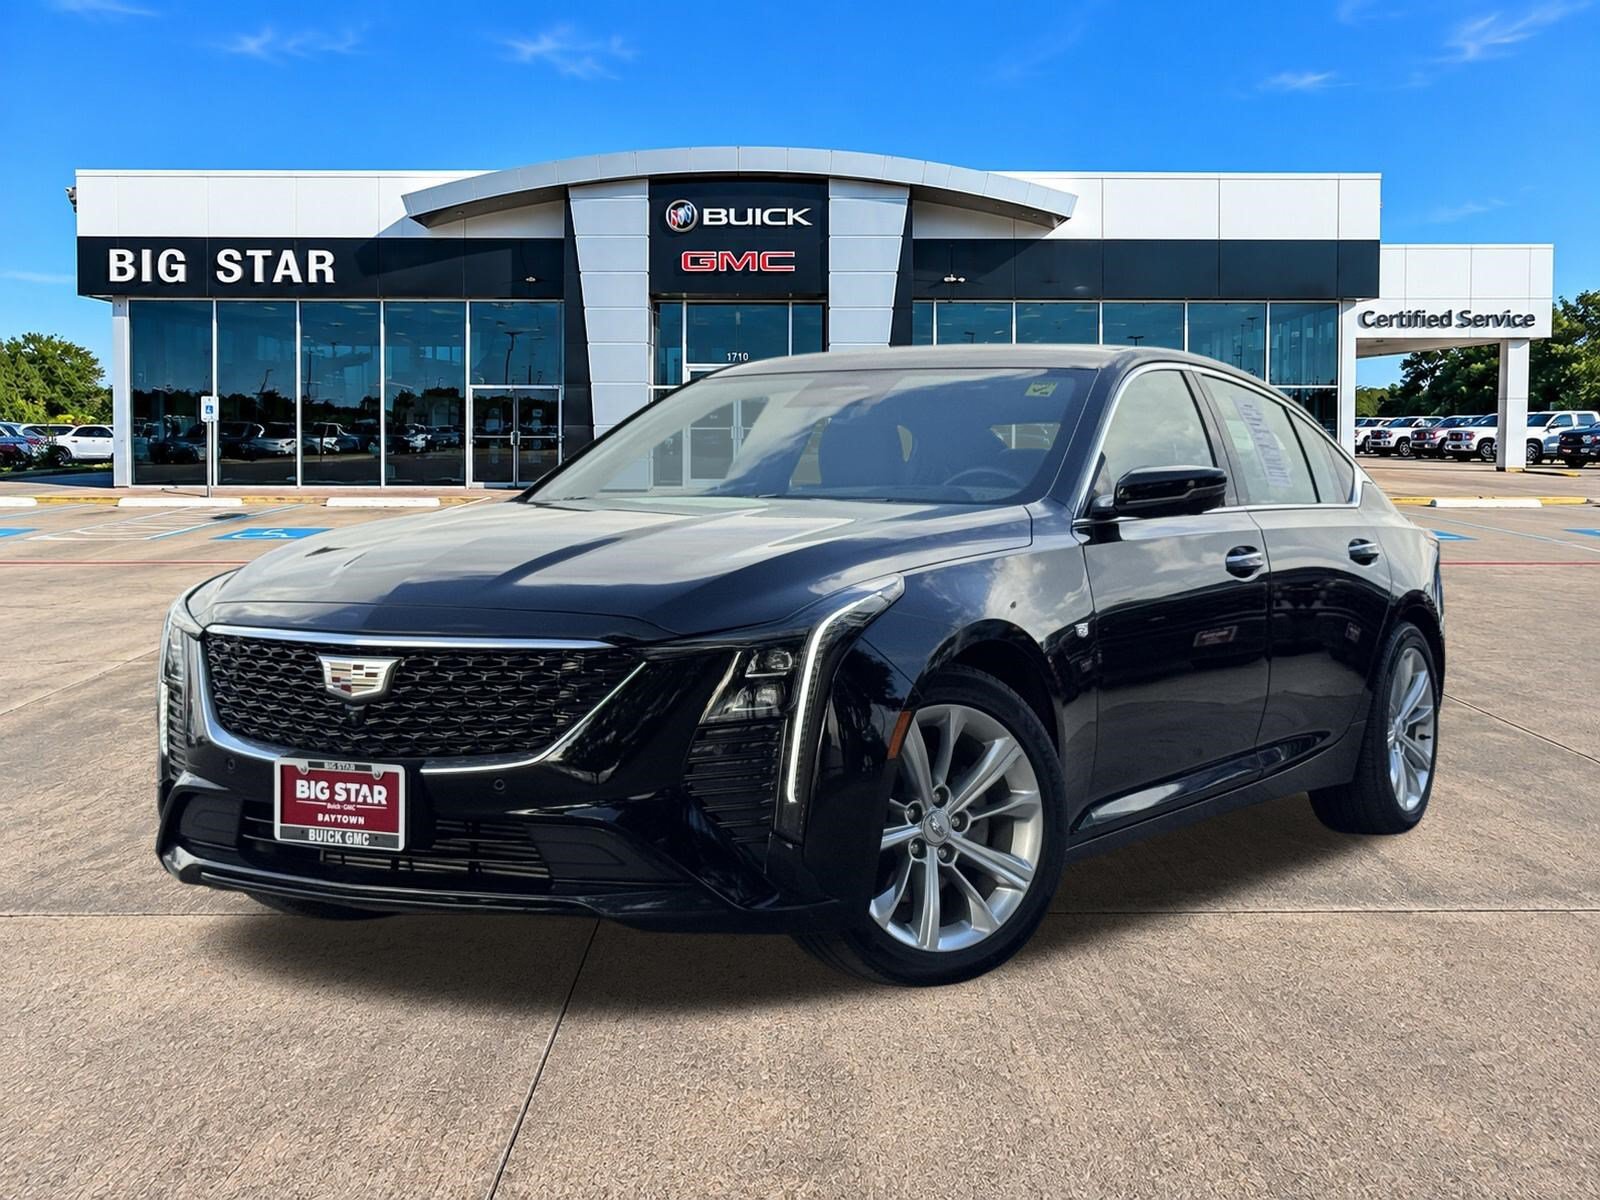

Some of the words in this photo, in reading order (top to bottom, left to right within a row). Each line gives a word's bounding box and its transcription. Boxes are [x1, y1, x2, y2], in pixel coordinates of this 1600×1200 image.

[703, 208, 812, 226] BUICK
[108, 248, 187, 283] BIG
[215, 248, 336, 284] STAR
[681, 251, 795, 272] GMC
[1360, 309, 1453, 329] Certified
[1457, 309, 1536, 329] Service
[727, 353, 749, 361] 1710
[338, 762, 356, 771] STAR
[295, 779, 330, 801] BIG
[334, 782, 388, 805] STAR
[317, 813, 365, 825] BAYTOWN
[308, 829, 343, 844] BUICK
[345, 832, 370, 846] GMC
